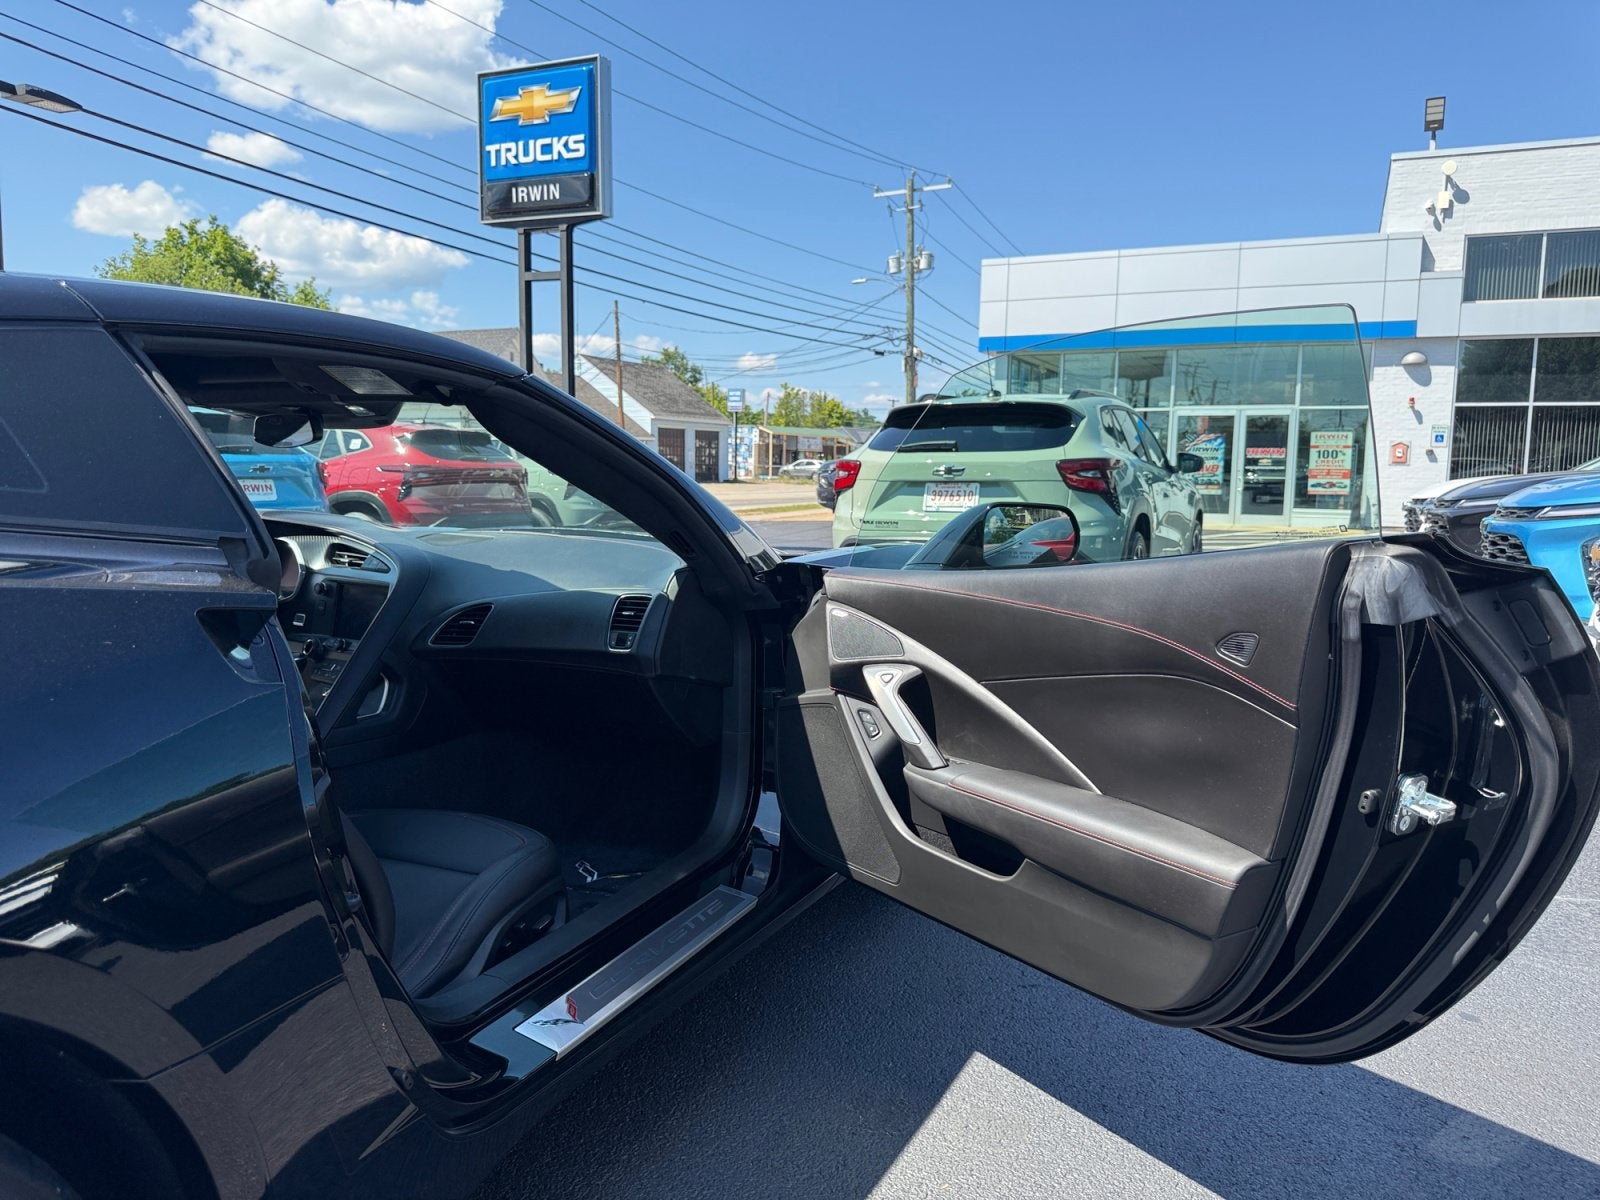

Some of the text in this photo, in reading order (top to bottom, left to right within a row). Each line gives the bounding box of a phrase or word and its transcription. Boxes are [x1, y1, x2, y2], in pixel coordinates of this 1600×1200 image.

[485, 133, 586, 168] TRUCKS
[511, 183, 560, 204] IRWIN
[1315, 449, 1346, 459] 100%
[243, 484, 273, 492] RWIN
[930, 489, 975, 502] 3976510
[588, 899, 724, 1000] CORVETTE
